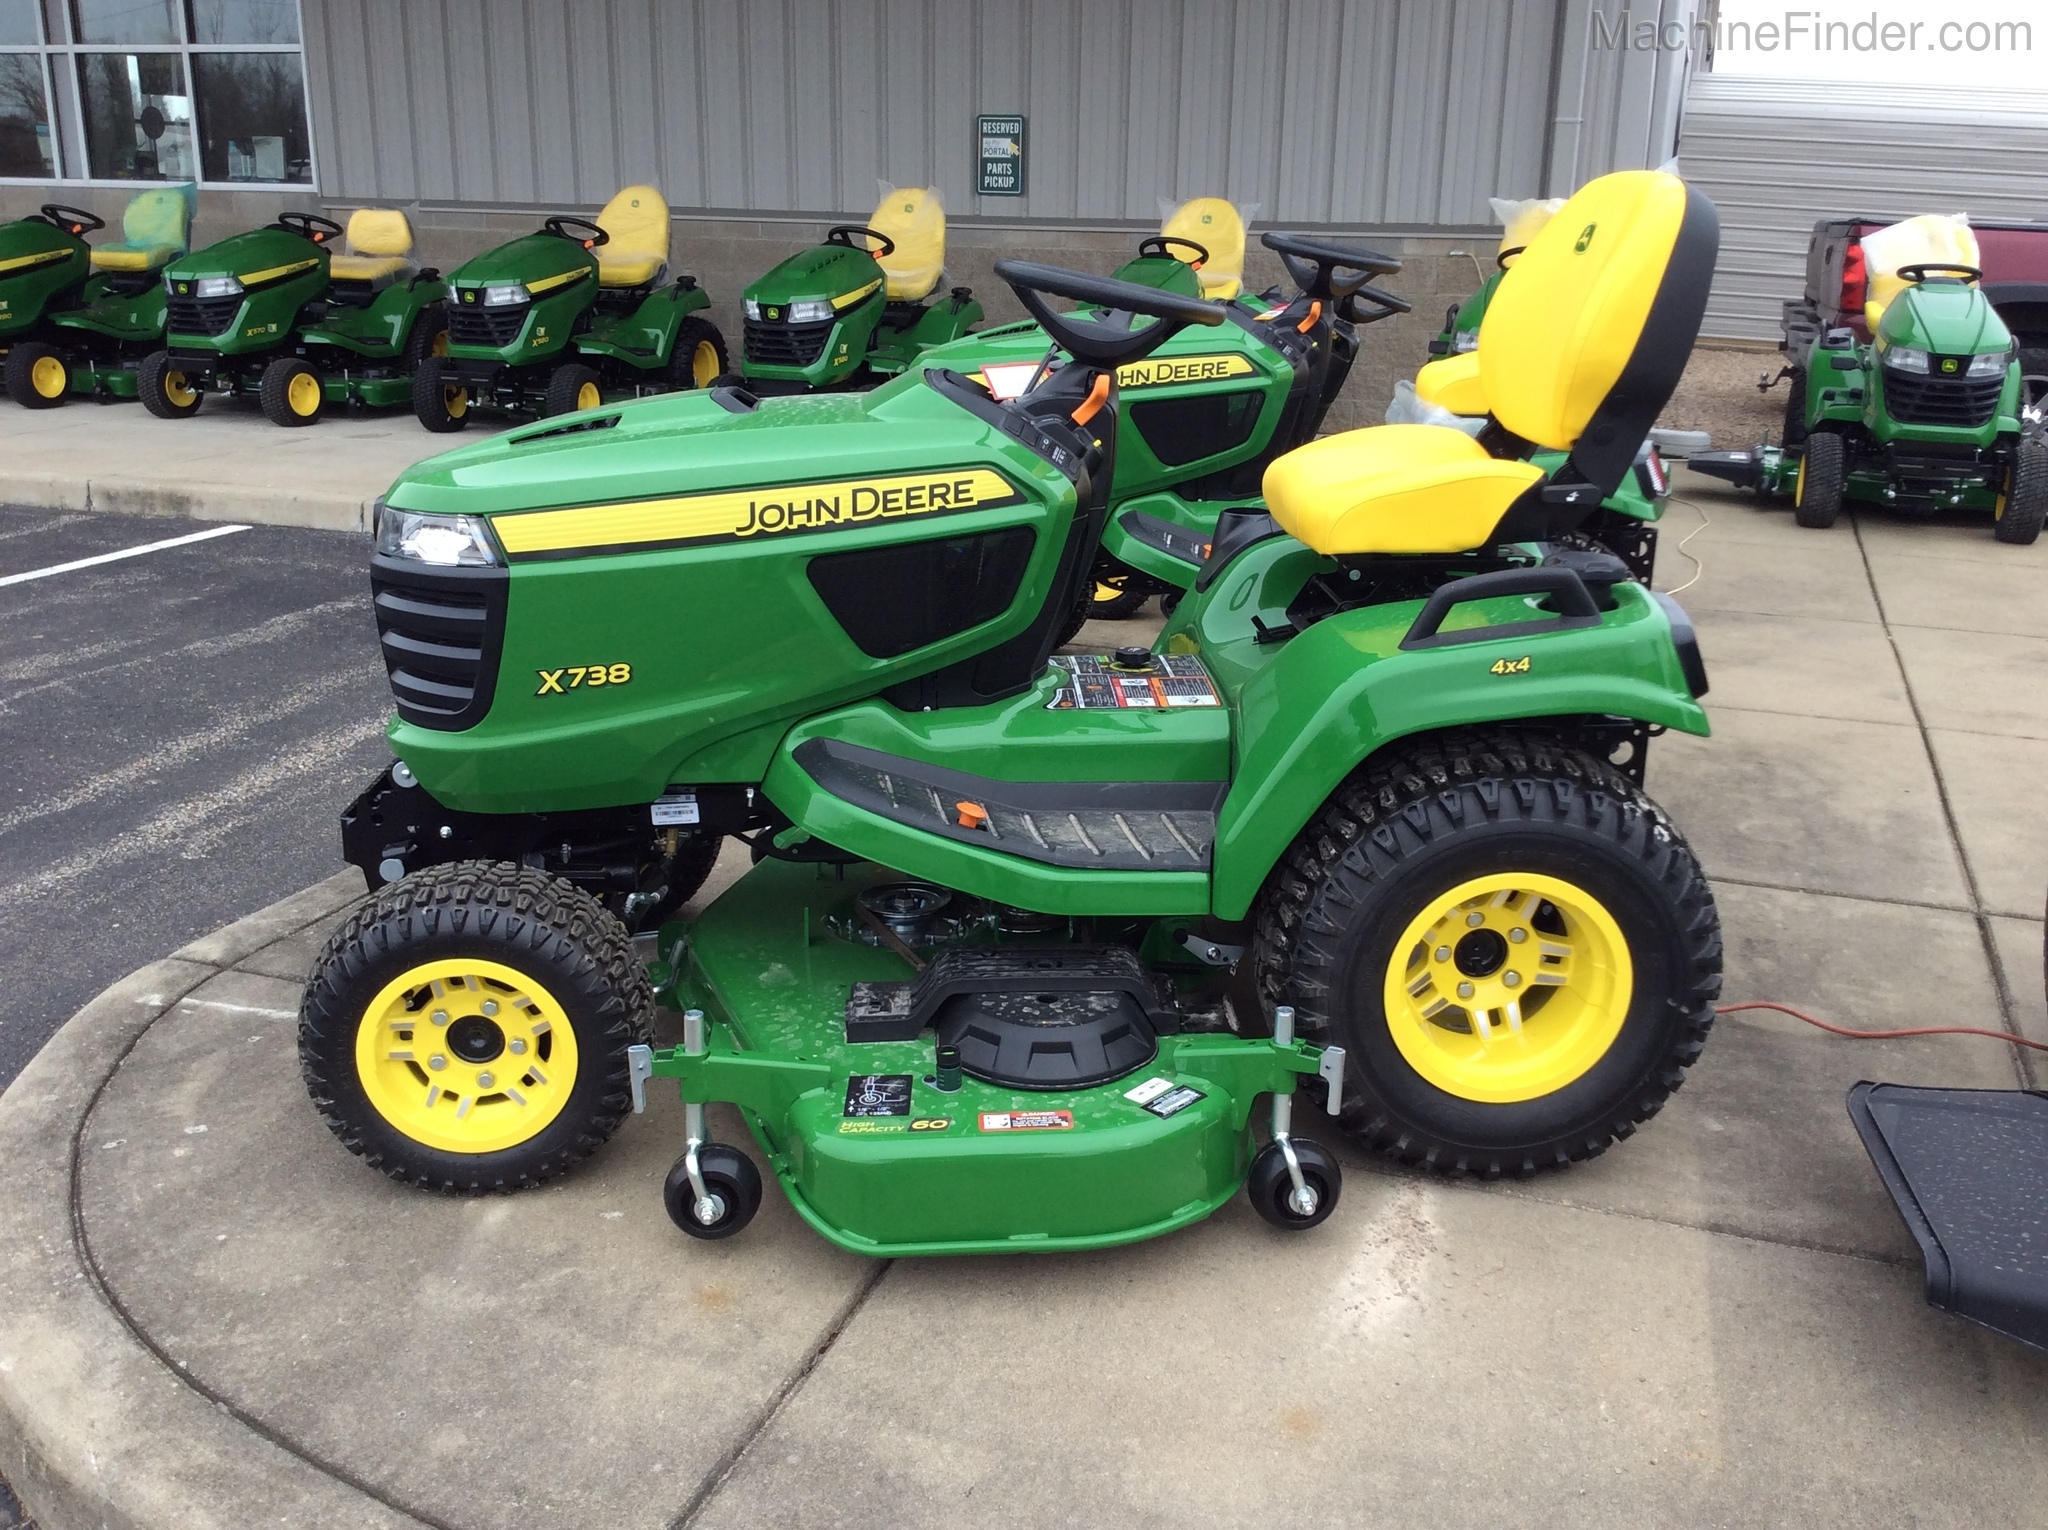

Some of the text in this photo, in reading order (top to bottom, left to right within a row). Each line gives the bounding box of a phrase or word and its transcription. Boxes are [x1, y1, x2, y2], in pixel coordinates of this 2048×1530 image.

[982, 122, 1019, 134] RESERVED
[983, 147, 1010, 156] PORTAL
[986, 162, 1013, 175] PARTS
[984, 176, 1015, 188] PICKUP
[1118, 360, 1230, 385] HN DEERE
[735, 478, 975, 534] JOHN DEERE
[1489, 655, 1532, 676] 4x4
[534, 662, 633, 697] X738
[838, 1125, 906, 1134] CAPACITY
[841, 1119, 949, 1131] HIGH 60
